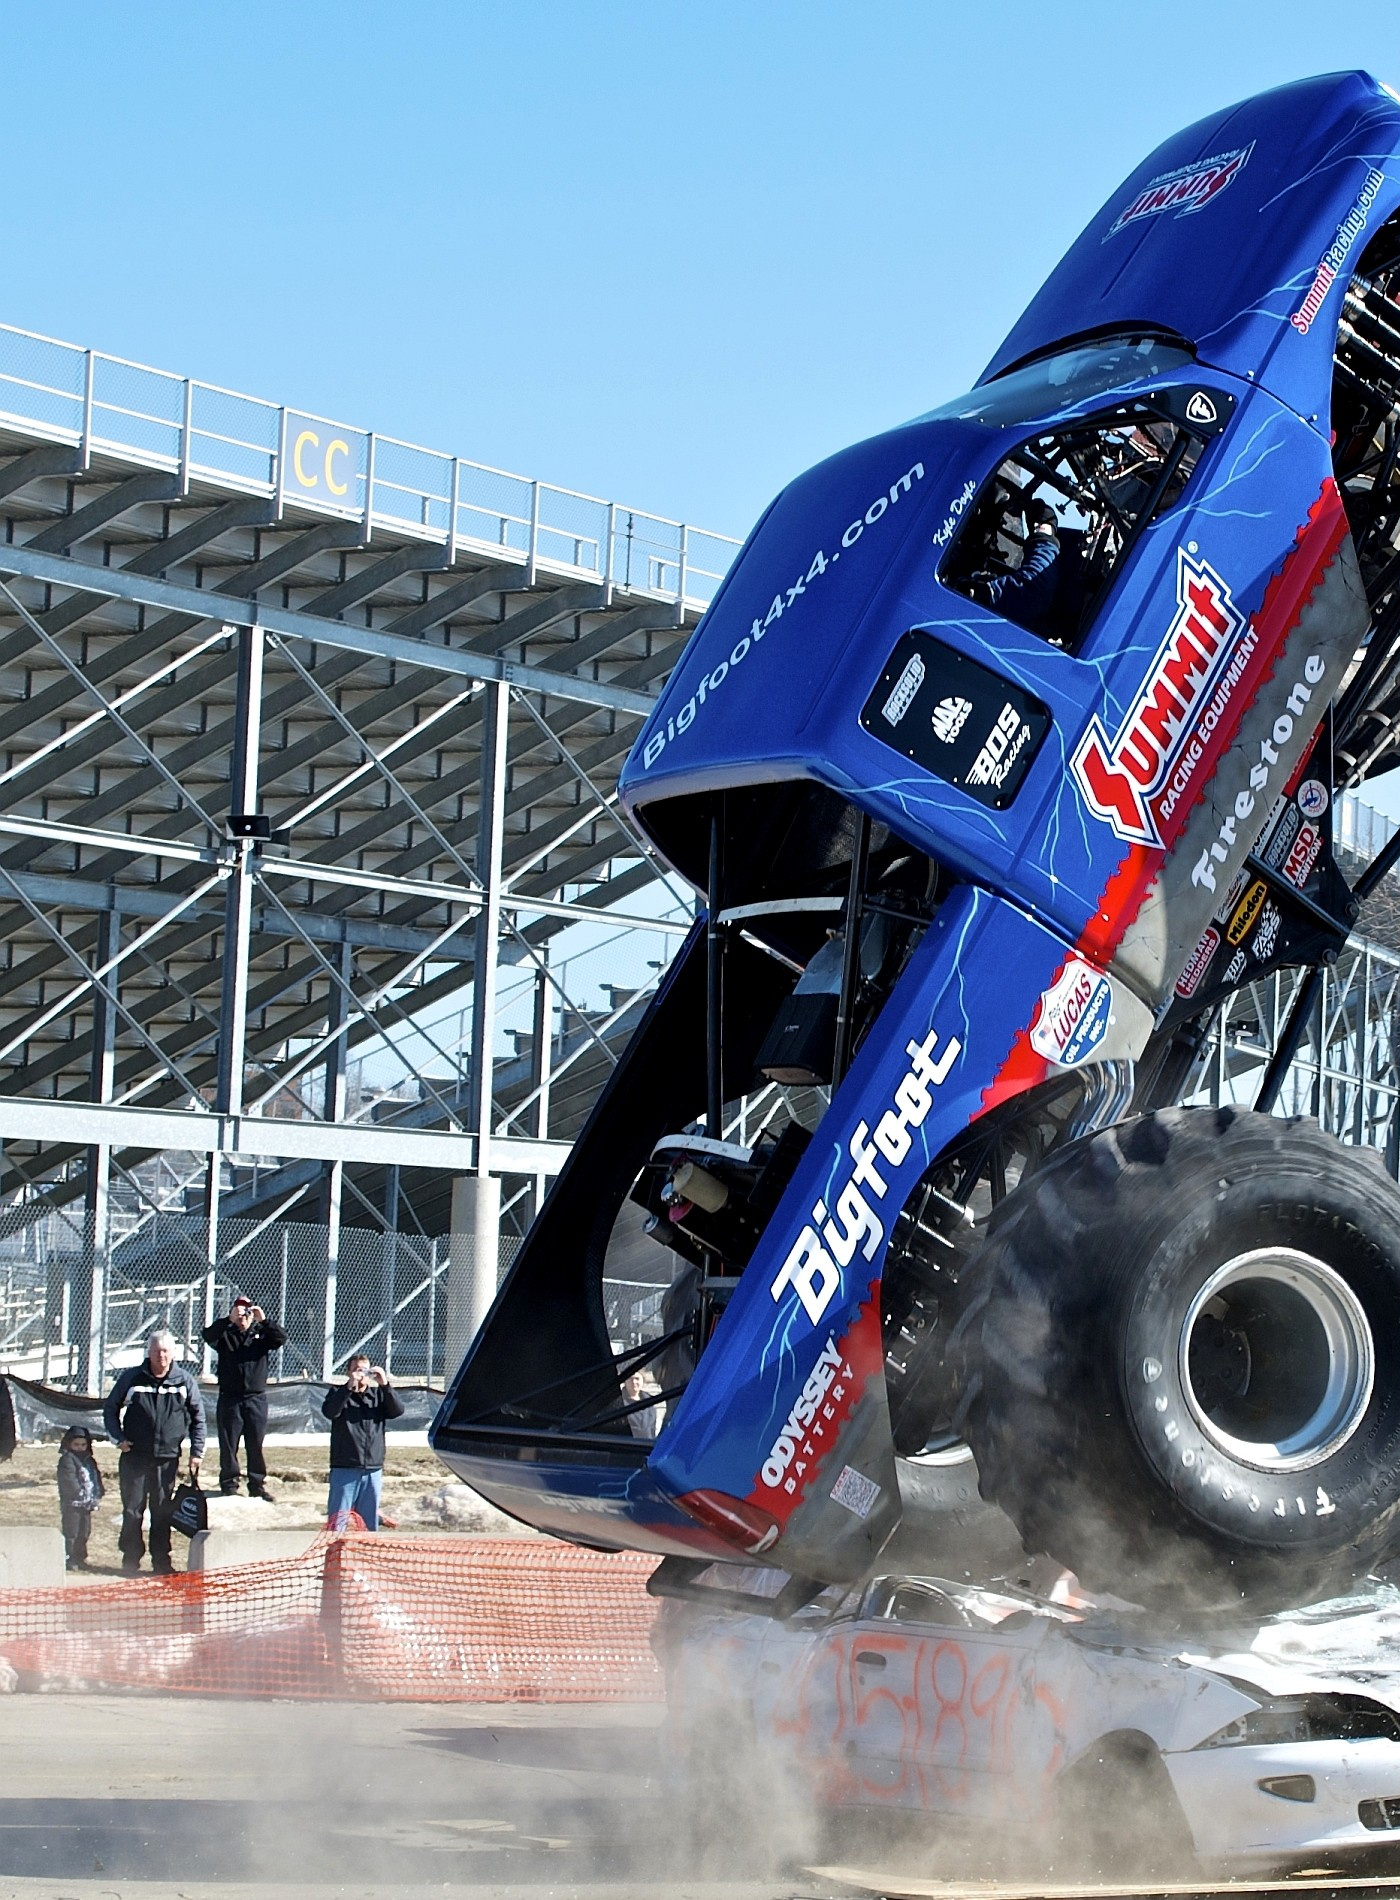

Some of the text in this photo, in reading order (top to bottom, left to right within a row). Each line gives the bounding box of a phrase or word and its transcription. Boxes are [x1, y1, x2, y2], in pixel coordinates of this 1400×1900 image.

[1290, 168, 1385, 334] SummitRacing.com
[294, 430, 349, 496] CC
[933, 480, 976, 547] Kyle Doyle
[642, 462, 926, 770] Bigfoot4x4.com
[885, 657, 923, 719] ROCKSOLID
[931, 697, 966, 742] MAC
[944, 702, 973, 744] TOOLS
[967, 702, 1021, 785] BDS
[1160, 624, 1261, 821] RACING EQUIPMENT
[990, 725, 1031, 789] Racing
[1191, 655, 1326, 893] Firestone
[1267, 810, 1297, 866] ROCKSOLID
[1284, 827, 1315, 881] MSD
[1297, 838, 1322, 888] IGNITION
[1229, 885, 1265, 942] Milodon
[1177, 932, 1211, 988] HEDMAN
[1185, 937, 1216, 992] HEDDERS
[1053, 973, 1092, 1051] LUCAS
[1065, 983, 1109, 1063] OIL PRODUCTS
[1088, 1019, 1105, 1043] INC.
[771, 1029, 962, 1326] Bigfoot
[761, 1336, 843, 1488] ODYSSEY
[784, 1363, 854, 1496] BATTERY
